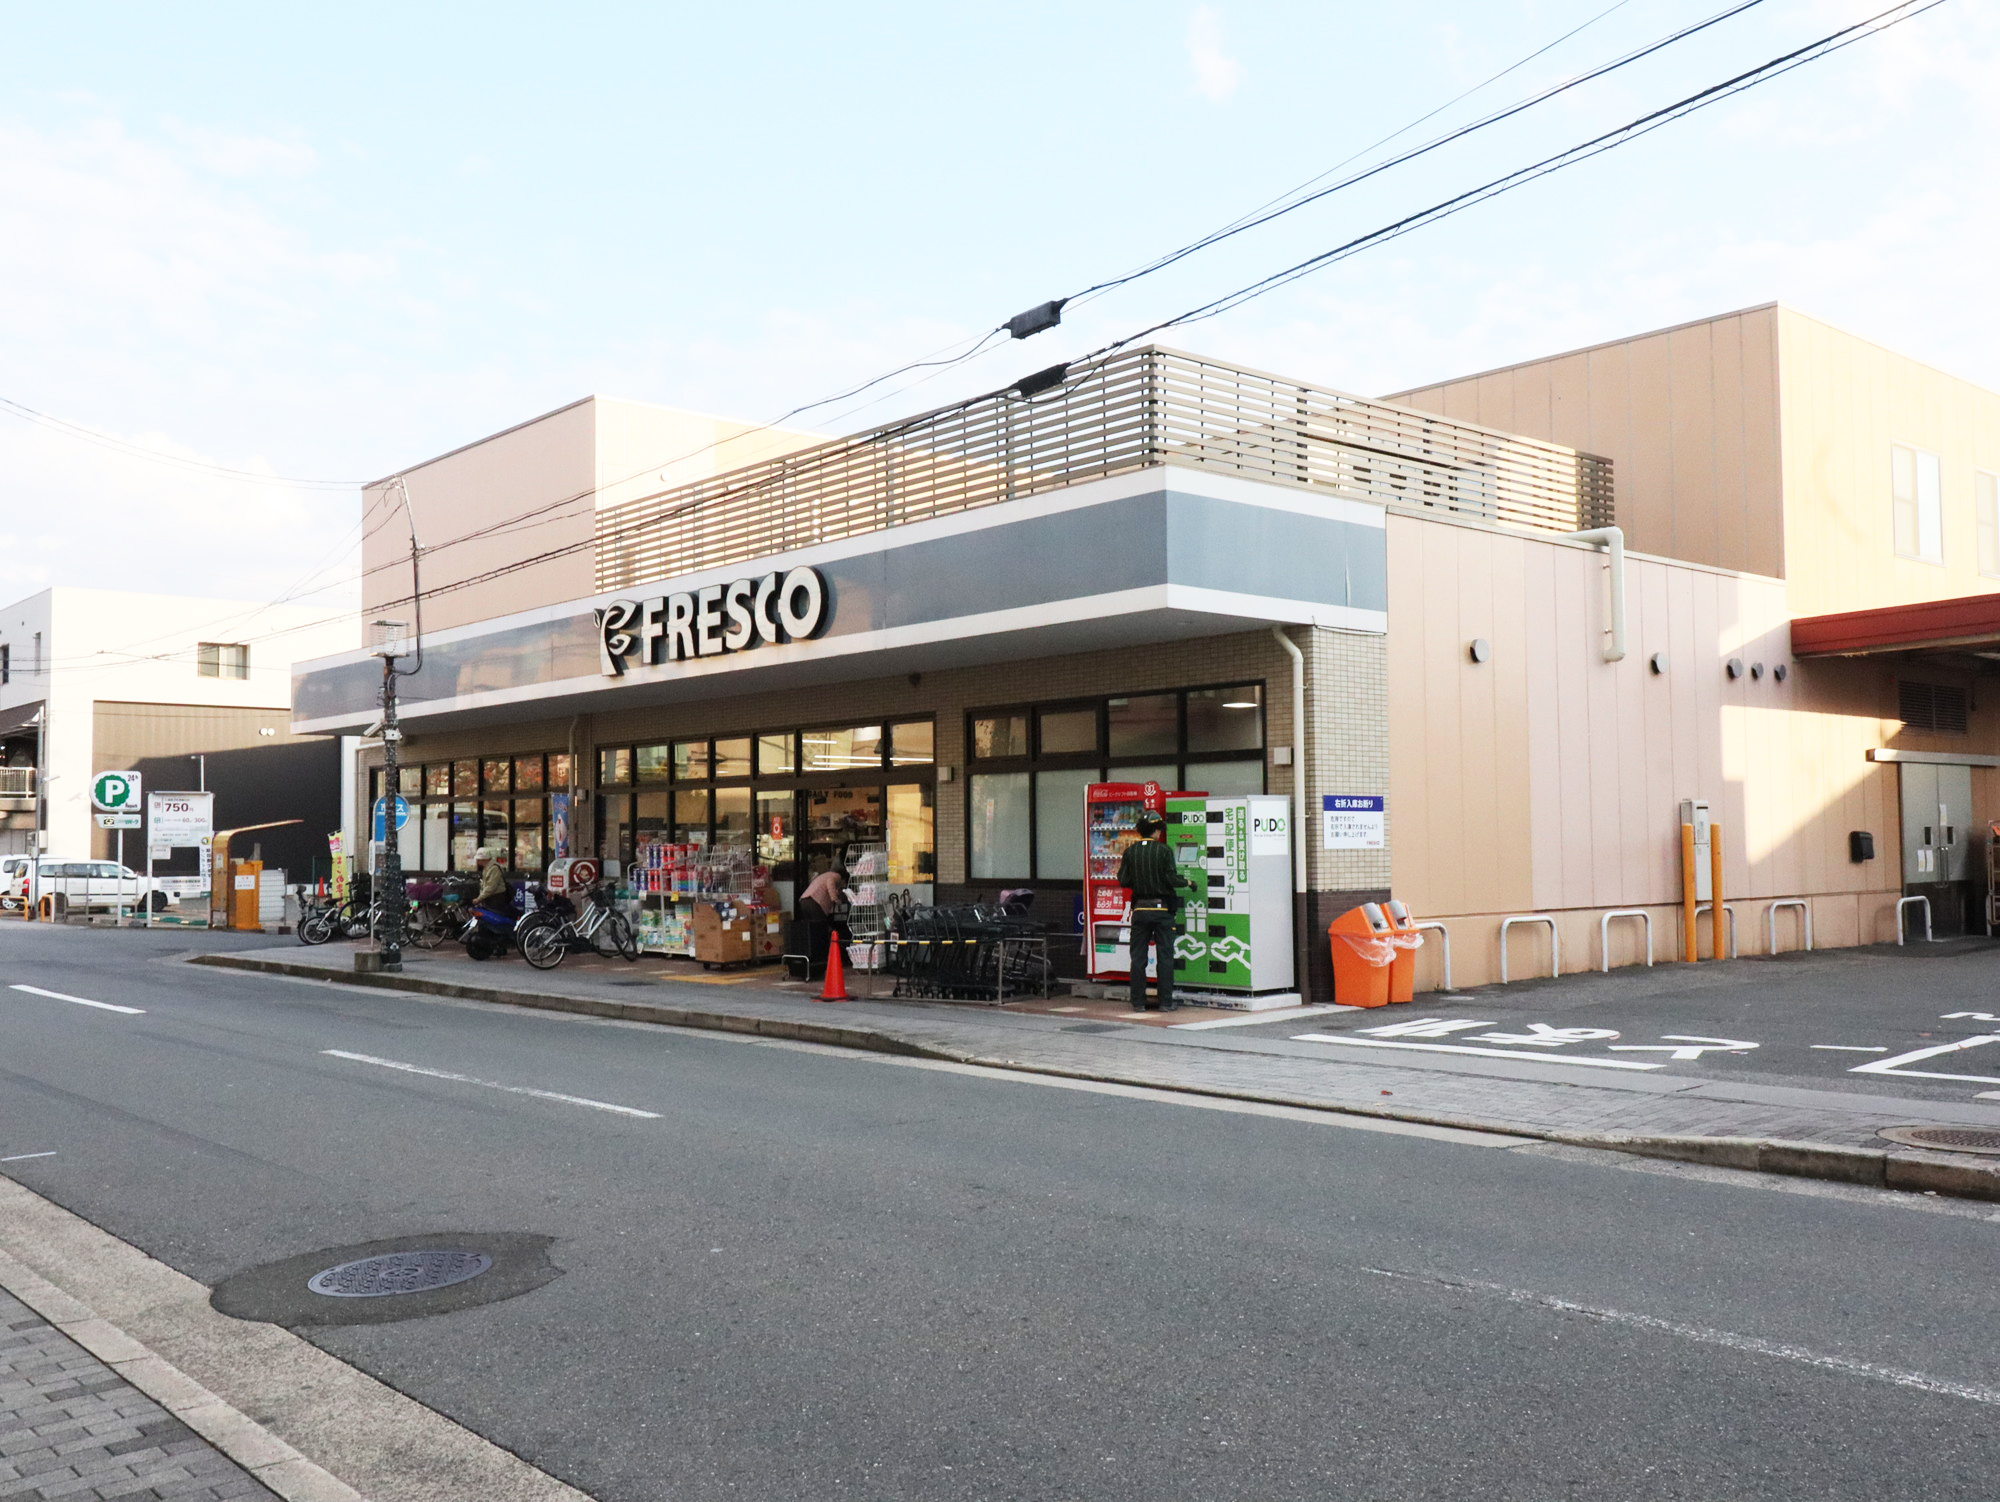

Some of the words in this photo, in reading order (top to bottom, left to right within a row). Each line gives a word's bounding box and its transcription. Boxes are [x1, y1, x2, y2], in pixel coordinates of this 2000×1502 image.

[641, 565, 826, 665] FRESCO
[105, 779, 125, 804] P
[1183, 814, 1205, 823] PUDO
[1254, 818, 1286, 832] PUDO
[1224, 807, 1235, 911] 宅配便ロッカー
